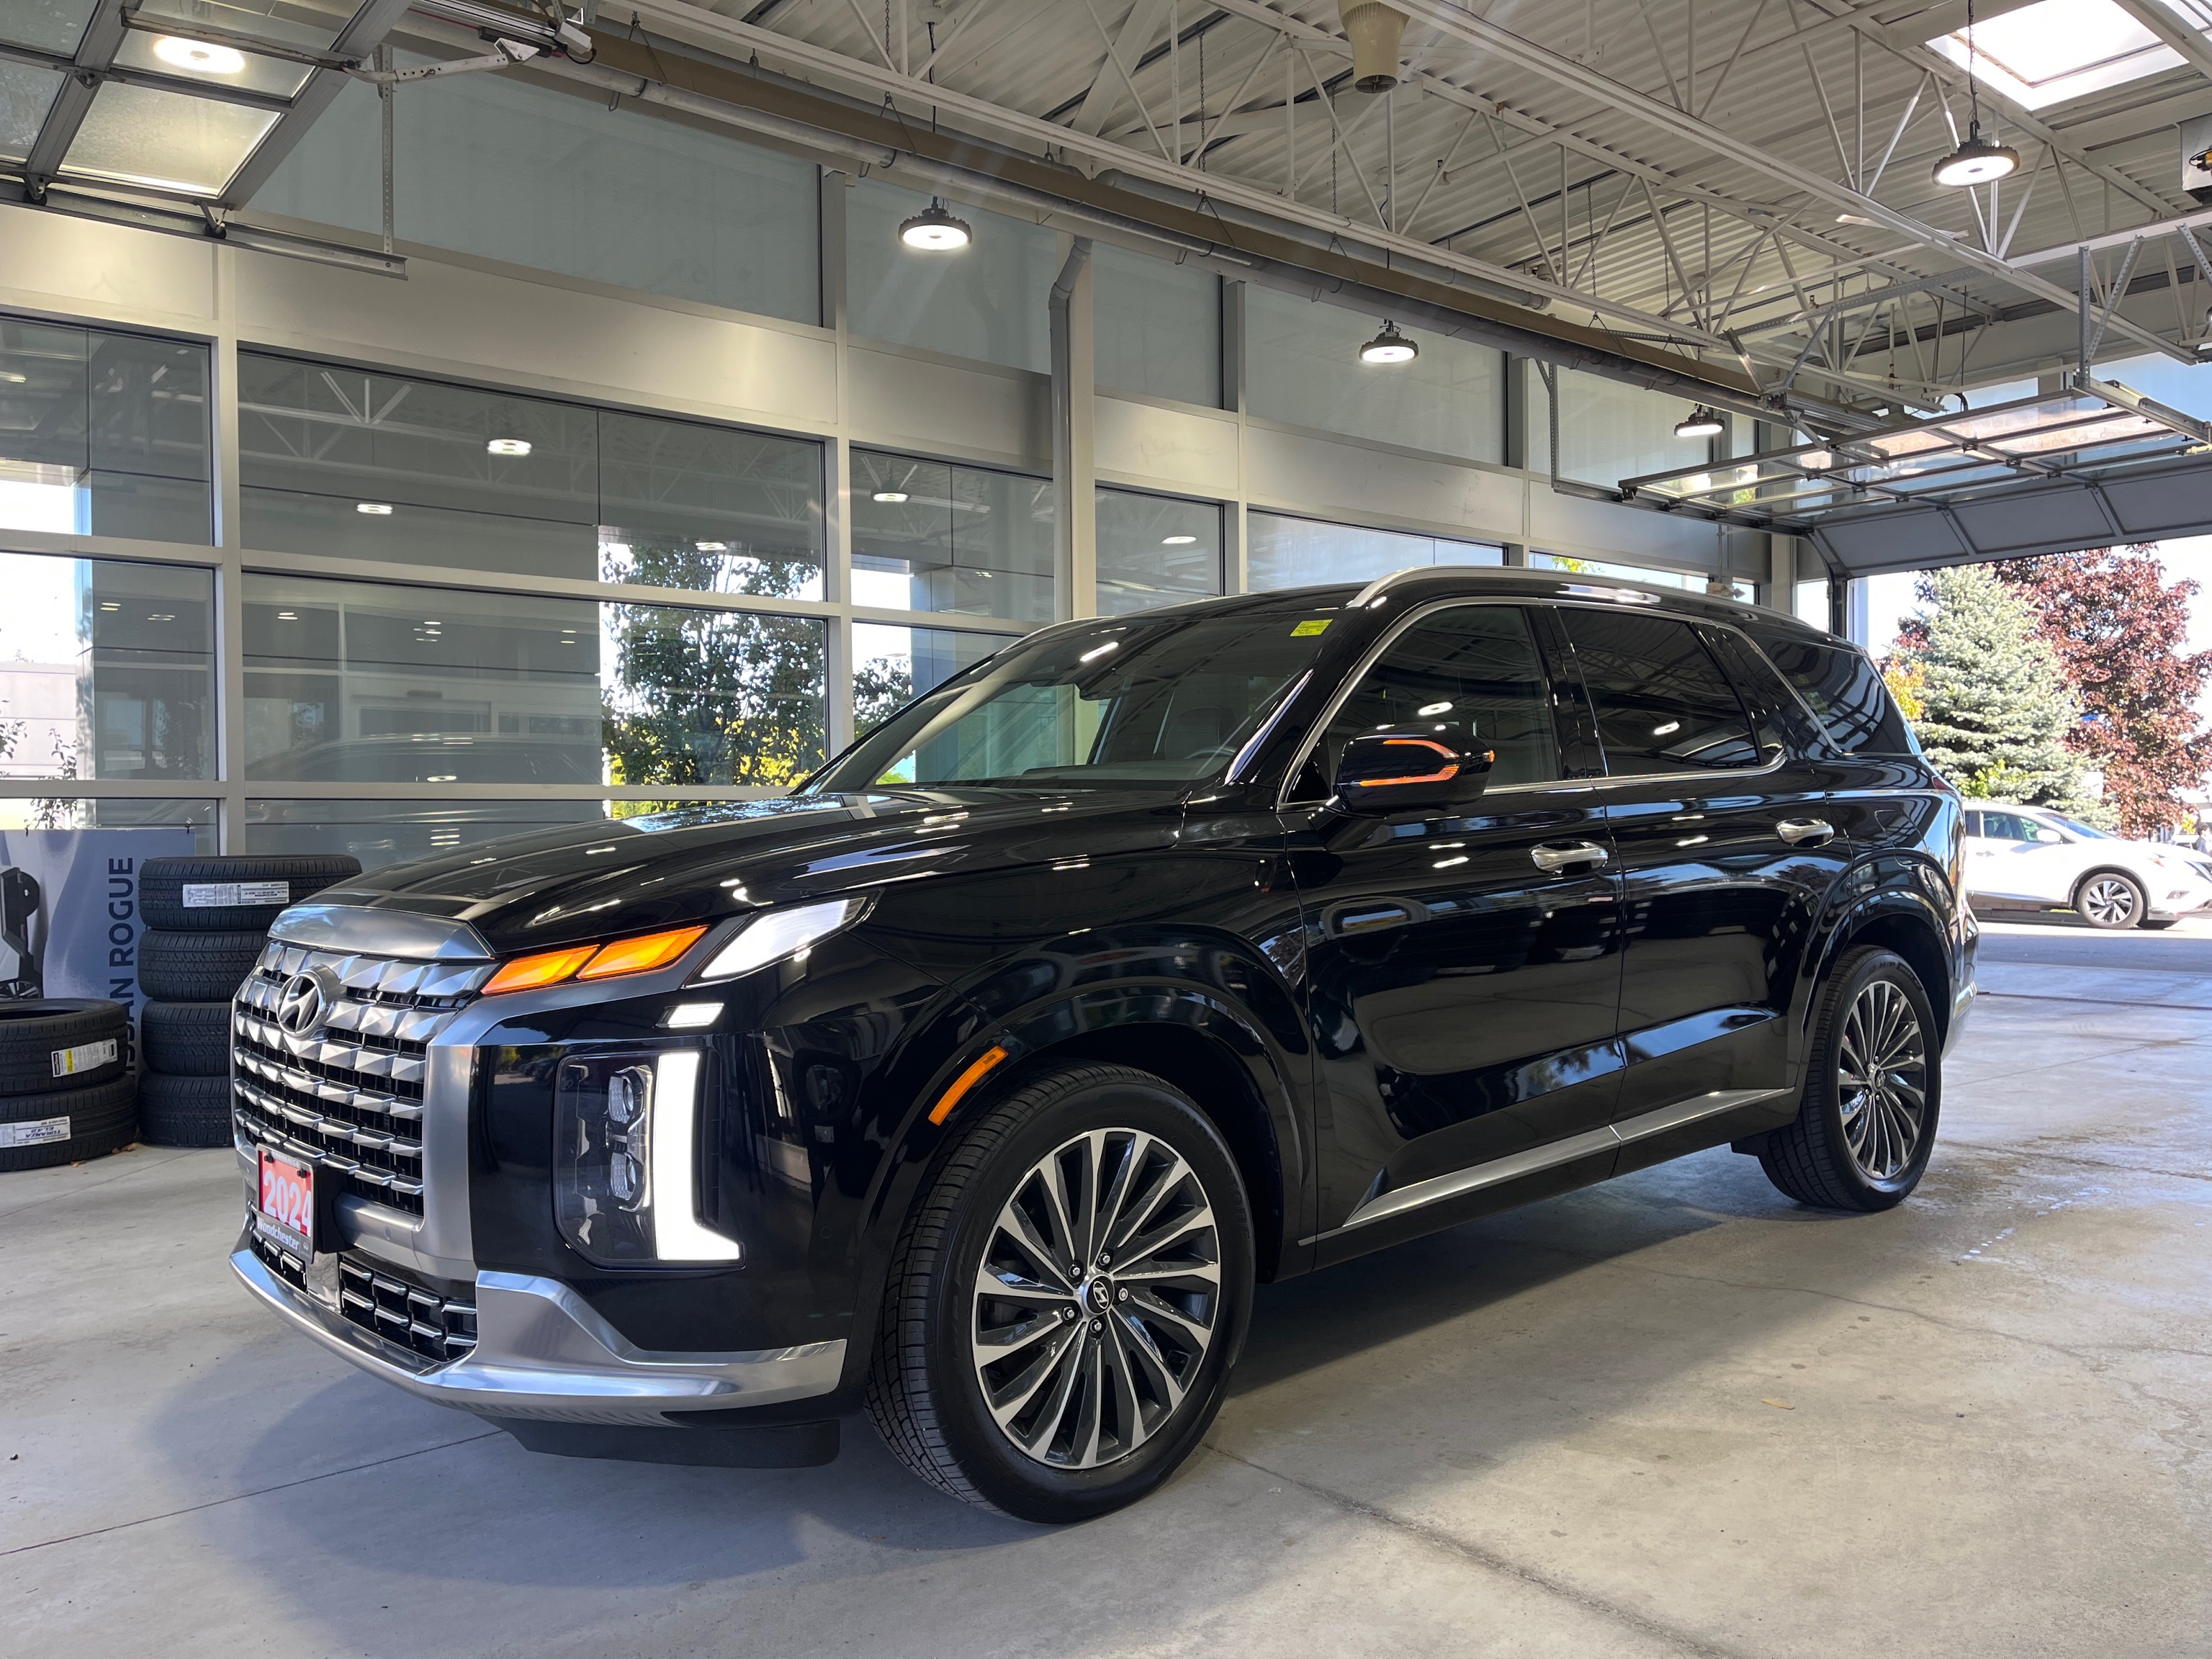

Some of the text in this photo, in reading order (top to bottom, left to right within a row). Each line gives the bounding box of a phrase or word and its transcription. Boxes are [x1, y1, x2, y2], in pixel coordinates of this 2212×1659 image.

[109, 858, 134, 967] ROGUE
[25, 1130, 60, 1138] TURANZA
[264, 1170, 312, 1238] 2024
[257, 1216, 300, 1251] Woodchester
